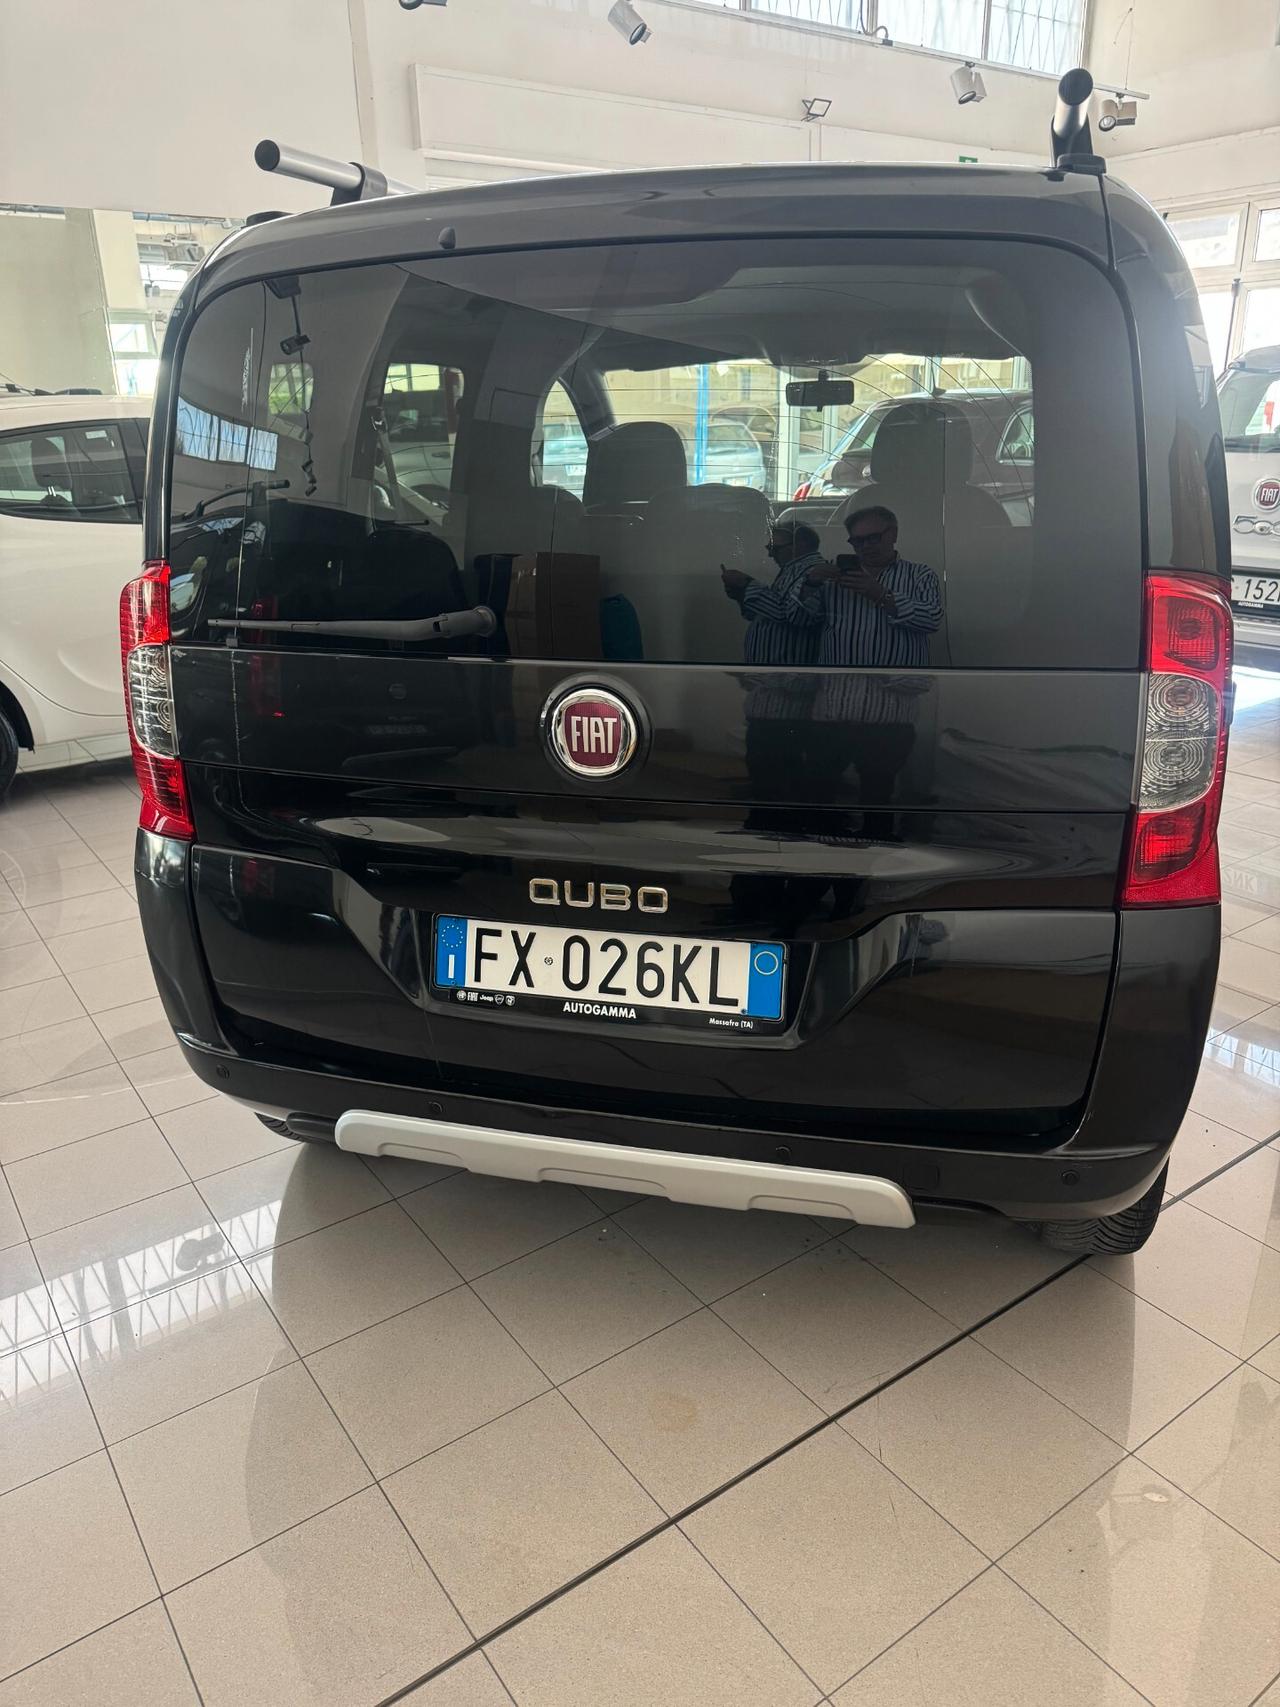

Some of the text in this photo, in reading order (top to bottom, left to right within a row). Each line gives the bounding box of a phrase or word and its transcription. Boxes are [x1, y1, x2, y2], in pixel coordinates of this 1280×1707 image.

[1260, 487, 1279, 502] FIAT
[1244, 578, 1280, 602] 152
[571, 715, 618, 754] FIAT
[529, 878, 668, 914] QUBO
[473, 927, 740, 1007] FX 026KL
[467, 991, 494, 1002] FIAT Jeep
[563, 1002, 637, 1019] AUTOGAMMA
[709, 1018, 754, 1029] Massafra (TA)
